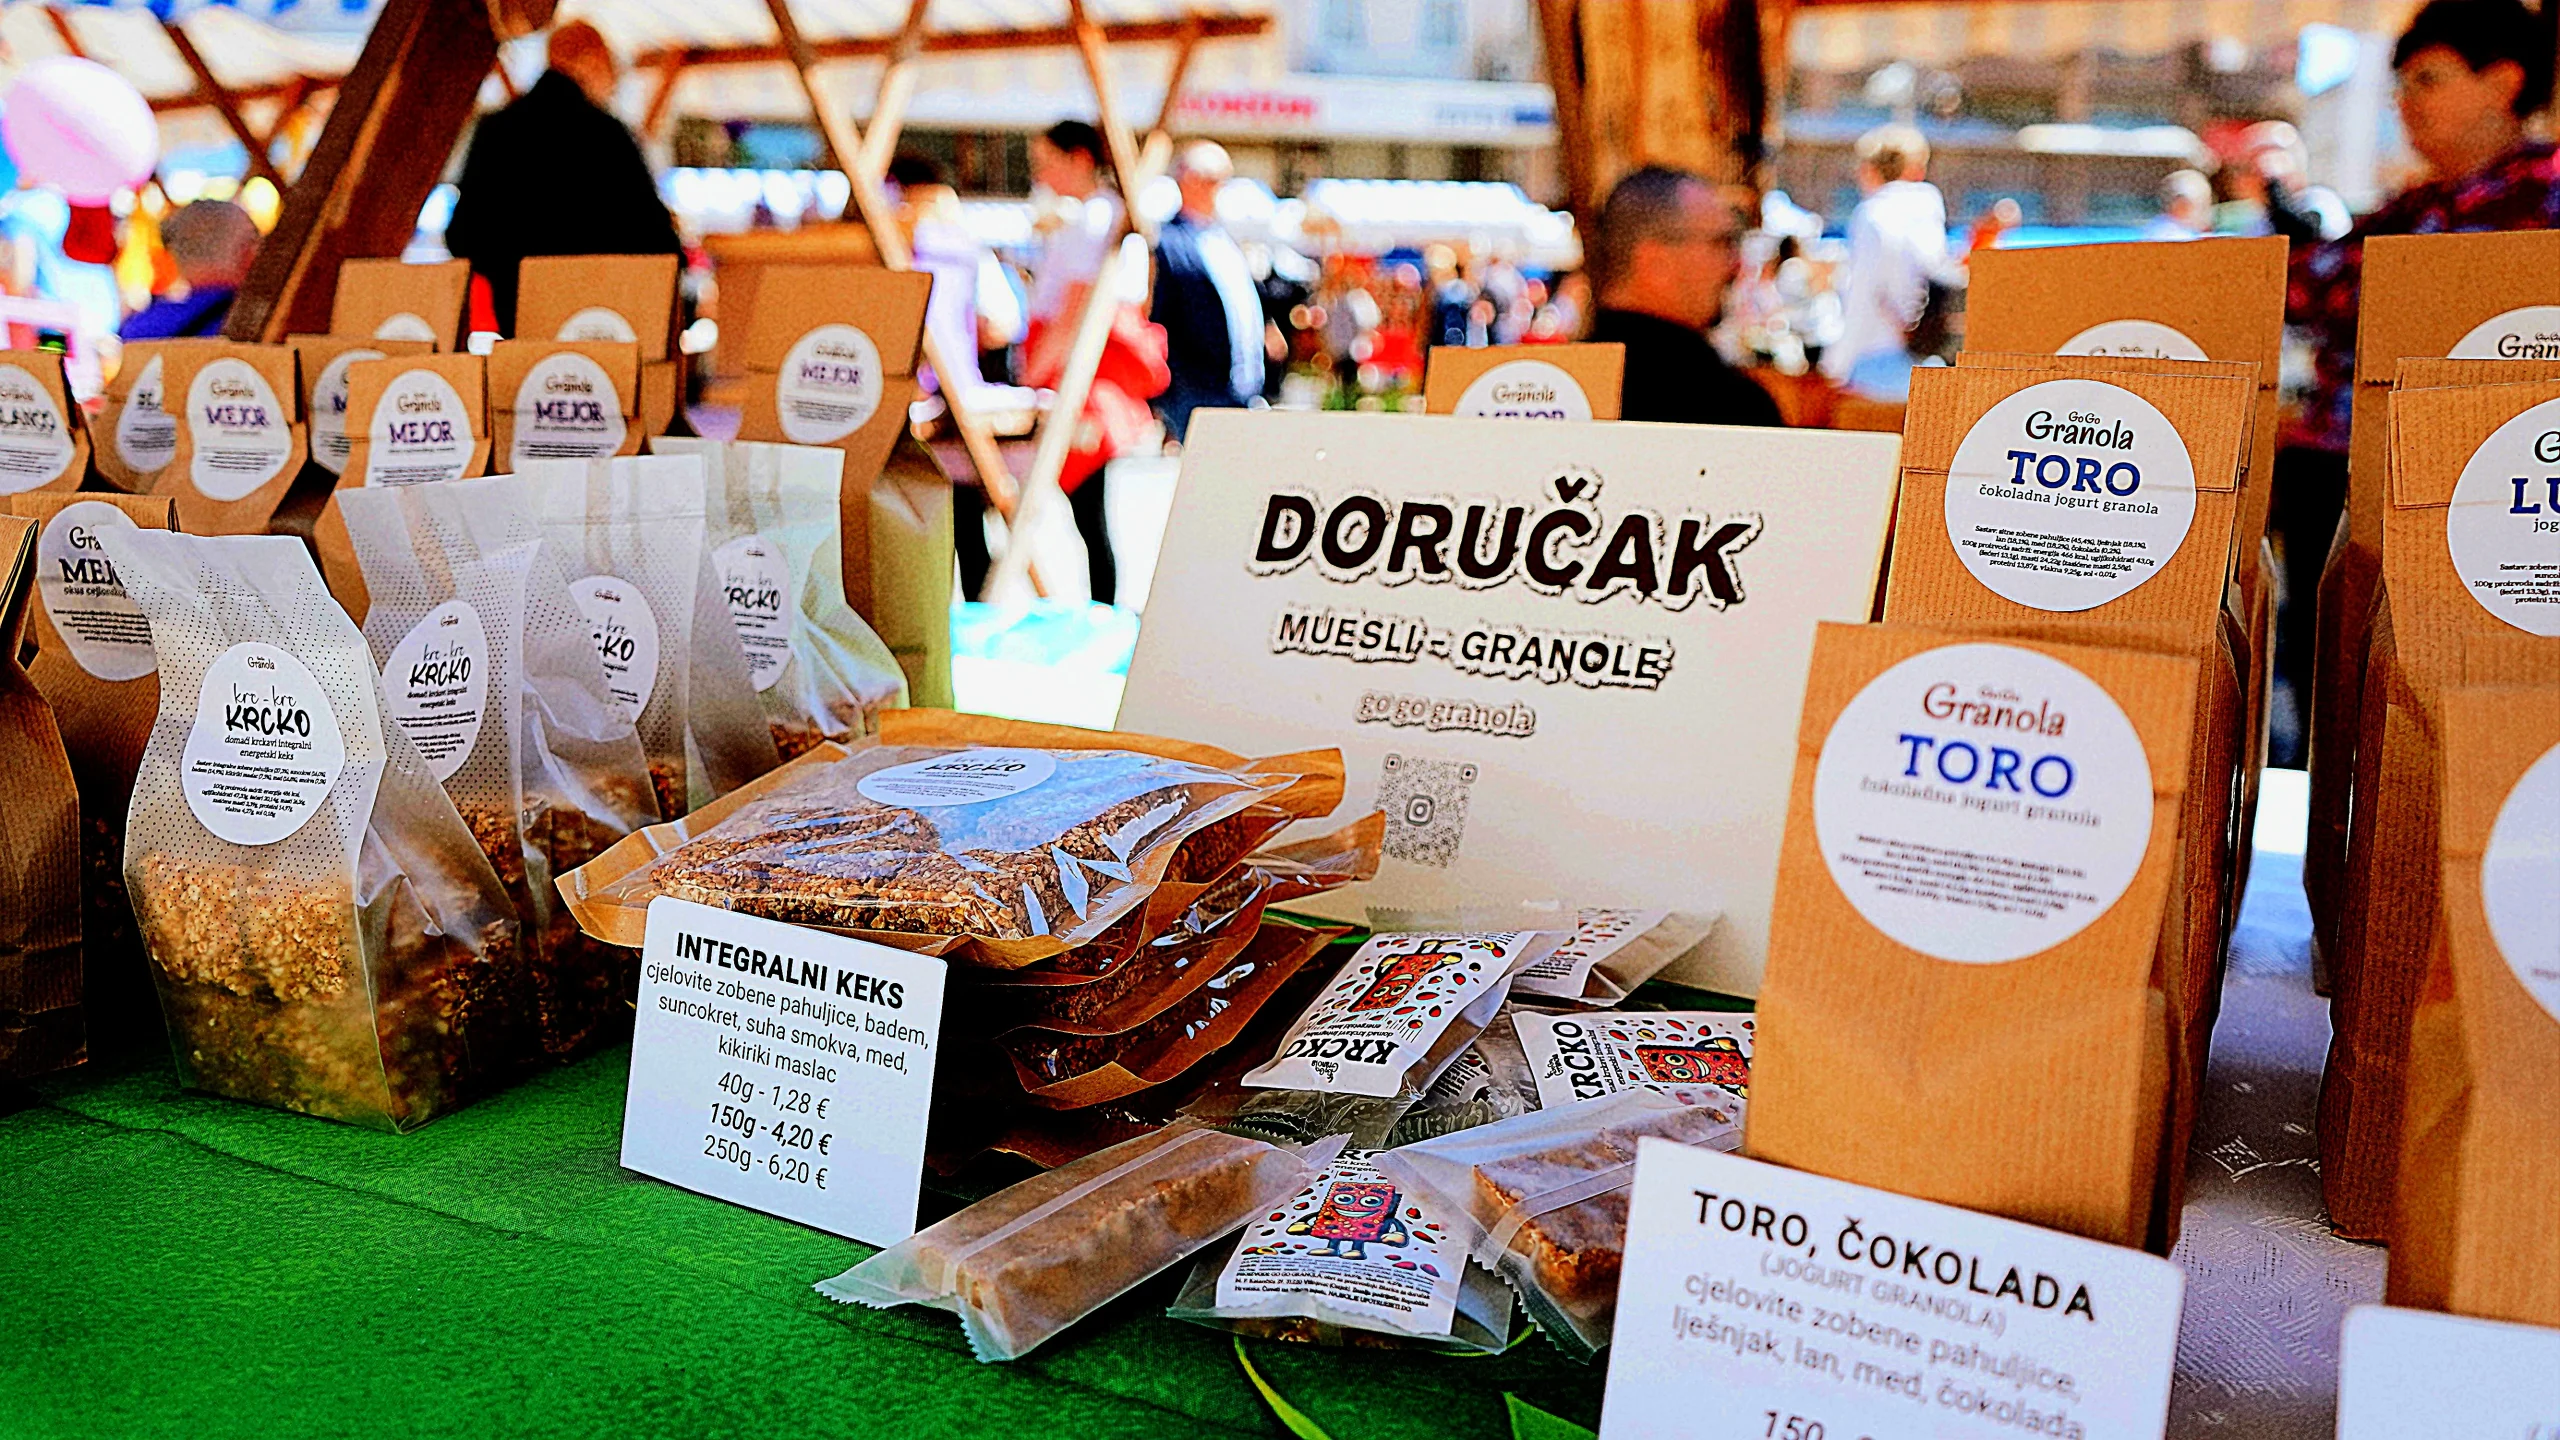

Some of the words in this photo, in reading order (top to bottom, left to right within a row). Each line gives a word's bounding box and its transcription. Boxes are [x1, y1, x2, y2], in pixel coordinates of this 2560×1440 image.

[2498, 333, 2560, 359] Gran
[205, 404, 270, 428] MEJOR
[389, 421, 455, 444] MEJOR
[535, 400, 606, 424] MEJOR
[2025, 411, 2134, 450] Granola
[2068, 411, 2100, 425] GoGo
[2007, 450, 2141, 497] TORO
[1979, 484, 2051, 503] čokoladna
[2054, 493, 2099, 509] jogurt
[2102, 500, 2159, 515] granola
[1254, 475, 1752, 602] DORUČAK
[1279, 612, 1418, 652] MUESLI
[1460, 630, 1664, 681] GRANOLE
[409, 656, 471, 687] KRCKO
[226, 704, 310, 737] KRCKO
[1359, 691, 1389, 718] go
[1394, 694, 1425, 723] go
[1432, 698, 1534, 732] granola
[1923, 682, 2066, 736] Granola
[225, 735, 250, 746] domaći
[251, 737, 277, 748] krckavi
[278, 739, 312, 750] integralni
[240, 749, 277, 760] energetski
[278, 751, 294, 760] keks
[1900, 733, 2074, 799] TORO
[676, 931, 828, 992] INTEGRALNI
[836, 969, 905, 1010] KEKS
[646, 962, 712, 993] cjelovite
[716, 980, 776, 1008] zobene
[780, 995, 860, 1033] pahuljice,
[865, 1012, 930, 1050] badem,
[658, 994, 742, 1032] suncokret,
[746, 1013, 785, 1041] suha
[791, 1026, 861, 1063] smokva,
[866, 1047, 909, 1075] med,
[718, 1034, 771, 1067] kikiriki
[775, 1052, 837, 1084] maslac
[1281, 1038, 1400, 1064] KRCKO
[1552, 1021, 1606, 1101] KRCKO
[718, 1071, 754, 1104] 40g
[771, 1085, 812, 1115] 1,28
[816, 1098, 830, 1120] €
[710, 1102, 756, 1139] 150g
[771, 1120, 814, 1151] 4,20
[819, 1133, 832, 1156] €
[703, 1134, 752, 1172] 250g
[768, 1153, 809, 1184] 6,20
[815, 1168, 828, 1190] €
[1692, 1190, 1819, 1259] TORO,
[1837, 1215, 2096, 1323] ČOKOLADA
[1760, 1248, 1865, 1297] (JOGURT
[1871, 1282, 2008, 1339] GRANOLA)
[1684, 1272, 1803, 1324] cjelovite
[1812, 1304, 1924, 1356] zobene
[1929, 1335, 2081, 1403] pahuljice,
[1672, 1305, 1788, 1366] lješnjak,
[1793, 1336, 1846, 1384] lan,
[1853, 1358, 1928, 1406] med,
[1936, 1378, 2087, 1440] čokolada
